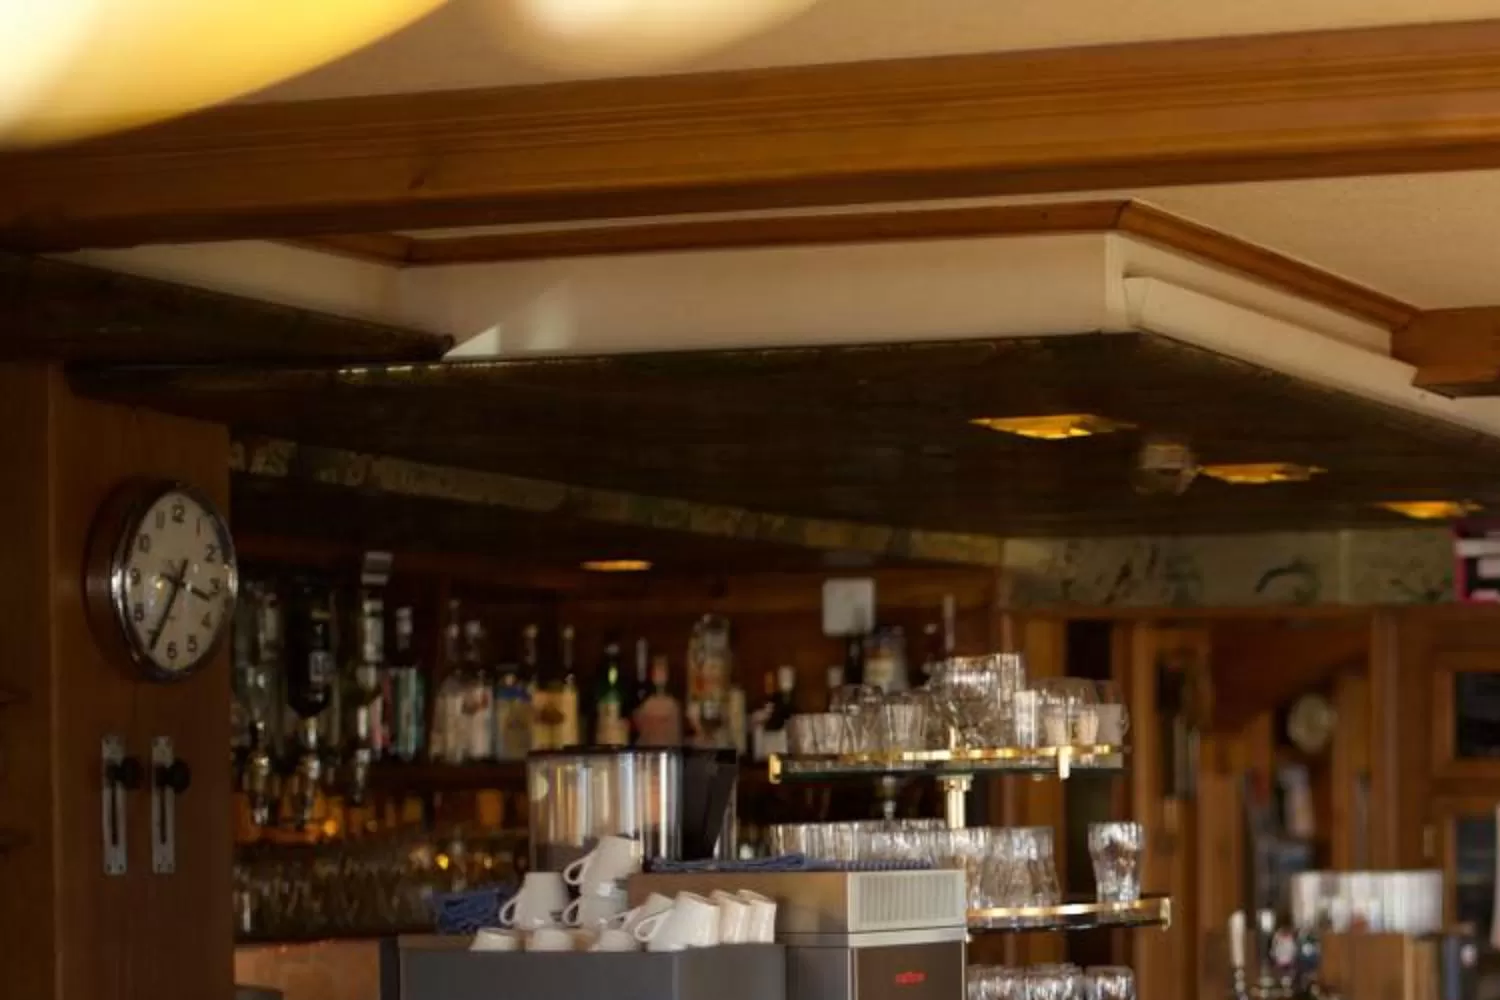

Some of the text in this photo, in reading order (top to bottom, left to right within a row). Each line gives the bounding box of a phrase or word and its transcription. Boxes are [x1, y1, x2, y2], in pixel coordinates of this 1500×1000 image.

[172, 504, 185, 523] 12
[205, 544, 216, 563] 2
[209, 577, 220, 596] 3
[201, 611, 211, 629] 4
[167, 641, 177, 660] 6
